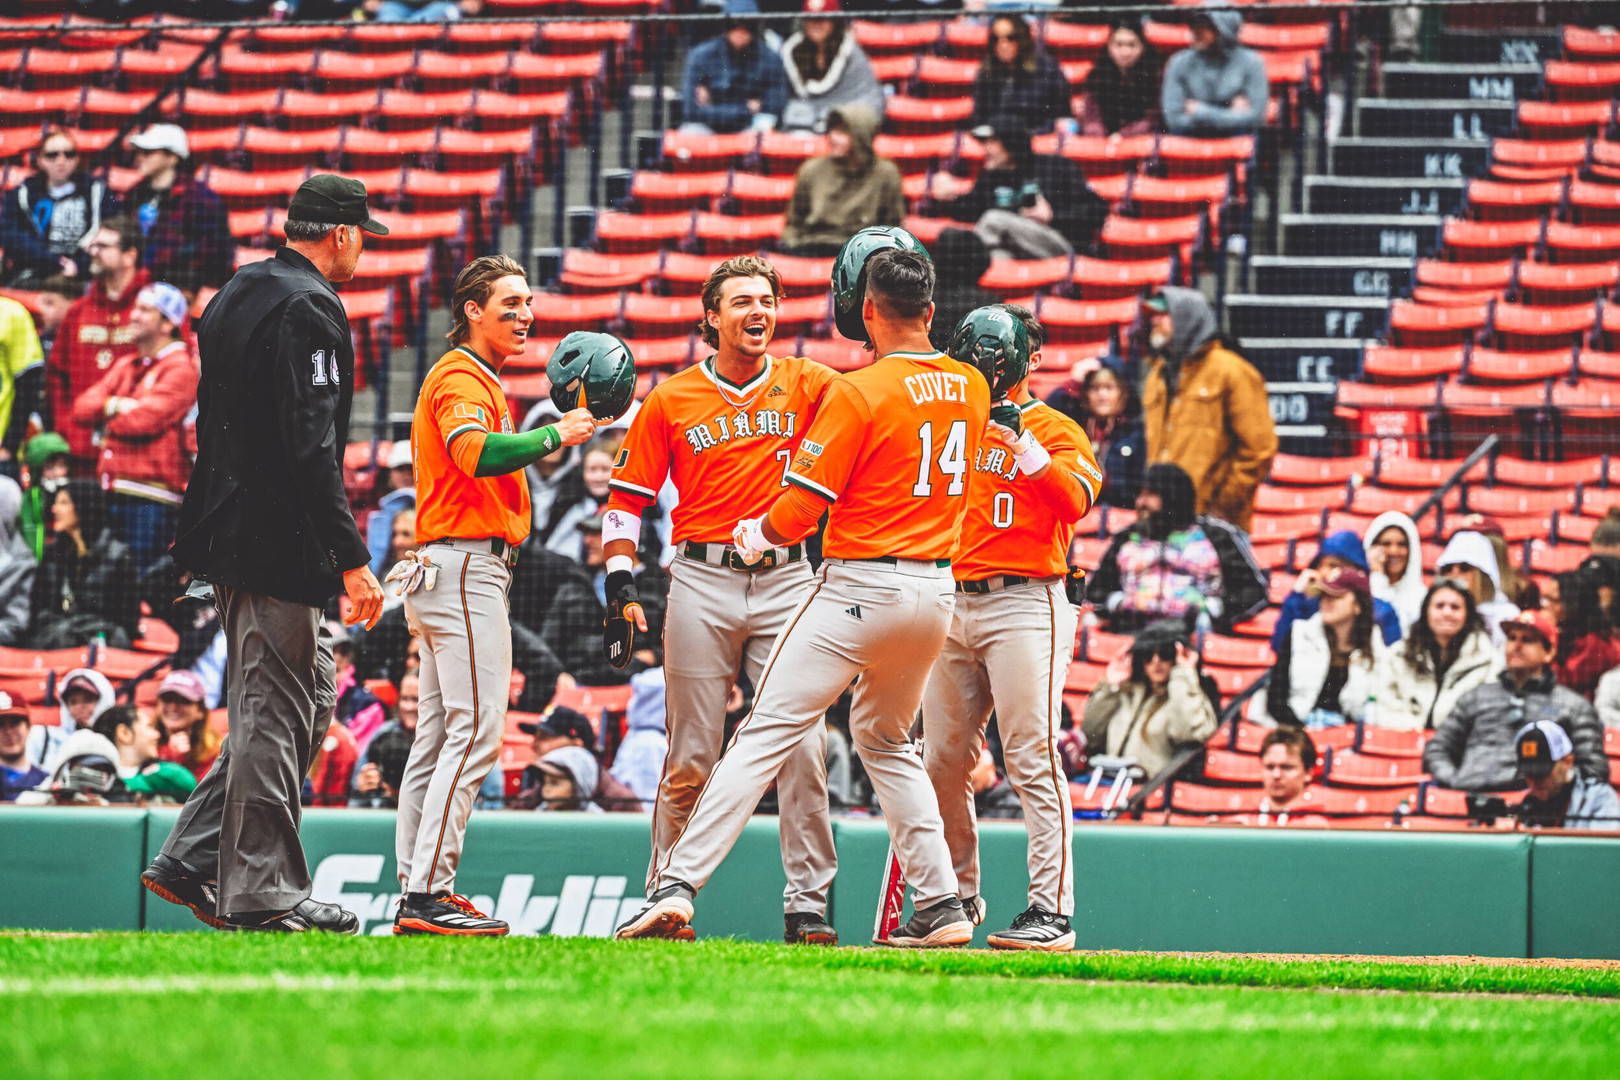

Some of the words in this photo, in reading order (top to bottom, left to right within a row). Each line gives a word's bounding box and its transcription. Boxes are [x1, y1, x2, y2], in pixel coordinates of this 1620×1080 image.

[1453, 113, 1489, 139] LL
[1424, 153, 1461, 177] KK
[1401, 190, 1439, 213] JJ
[1325, 310, 1363, 337] FF
[904, 371, 969, 405] CUVET
[685, 409, 797, 456] MIAMI
[912, 420, 967, 497] 14
[993, 491, 1014, 529] 0
[311, 854, 652, 938] Frkli
